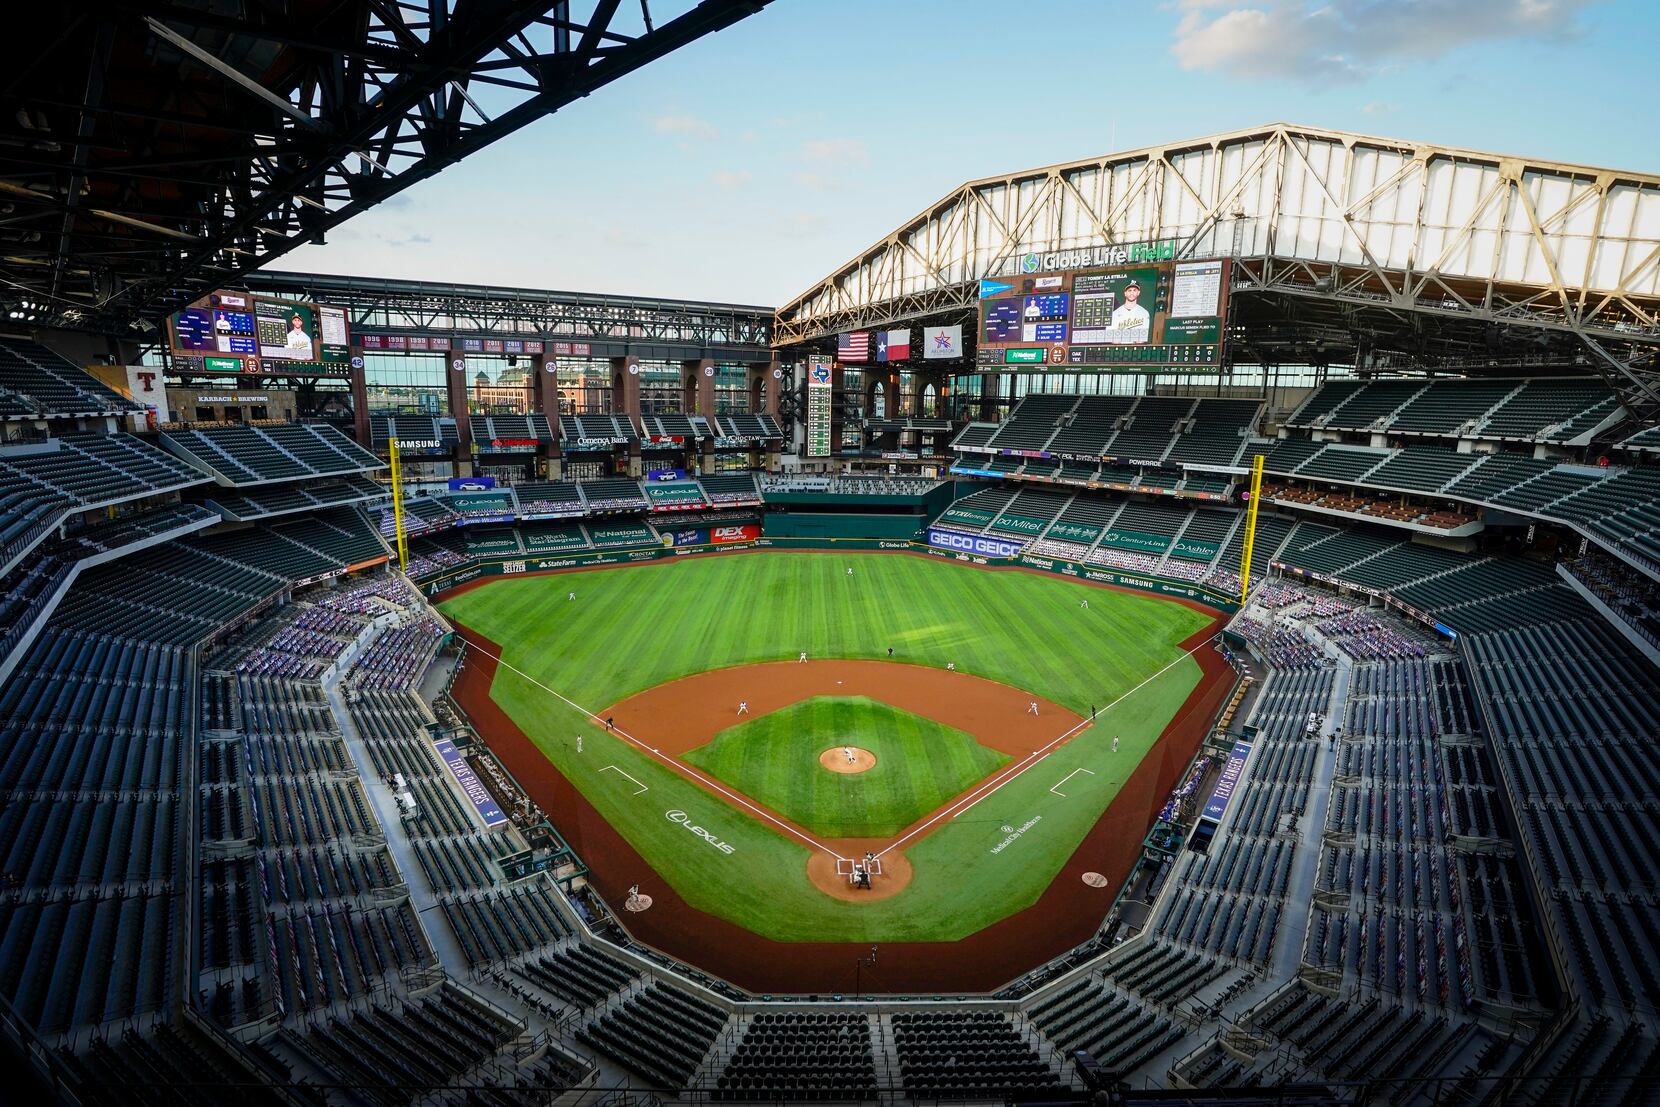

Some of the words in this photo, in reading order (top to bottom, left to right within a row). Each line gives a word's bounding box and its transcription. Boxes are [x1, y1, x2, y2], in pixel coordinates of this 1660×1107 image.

[1044, 251, 1091, 271] Globe
[1093, 247, 1127, 265] Life
[1131, 240, 1174, 262] Field
[454, 361, 464, 369] 34
[138, 372, 156, 391] T
[394, 440, 441, 448] SAMSUNG
[578, 437, 610, 446] Comerica
[611, 436, 628, 445] Bank
[1129, 459, 1161, 468] POWERADE
[1011, 519, 1044, 531] Mitel
[606, 529, 648, 537] National
[715, 526, 744, 537] DEX
[930, 532, 973, 549] GEICO
[976, 539, 1020, 557] GEICO
[1120, 536, 1165, 548] CenturyLink
[1184, 544, 1215, 556] Ashley
[1029, 557, 1053, 567] National
[503, 564, 526, 574] SELTZER
[1120, 577, 1153, 588] SAMSUNG
[1223, 756, 1244, 780] RANGERS
[448, 758, 470, 778] TEXAS
[461, 776, 490, 805] RANGERS
[1213, 779, 1234, 800] TEXAS
[683, 820, 736, 855] LEXUS
